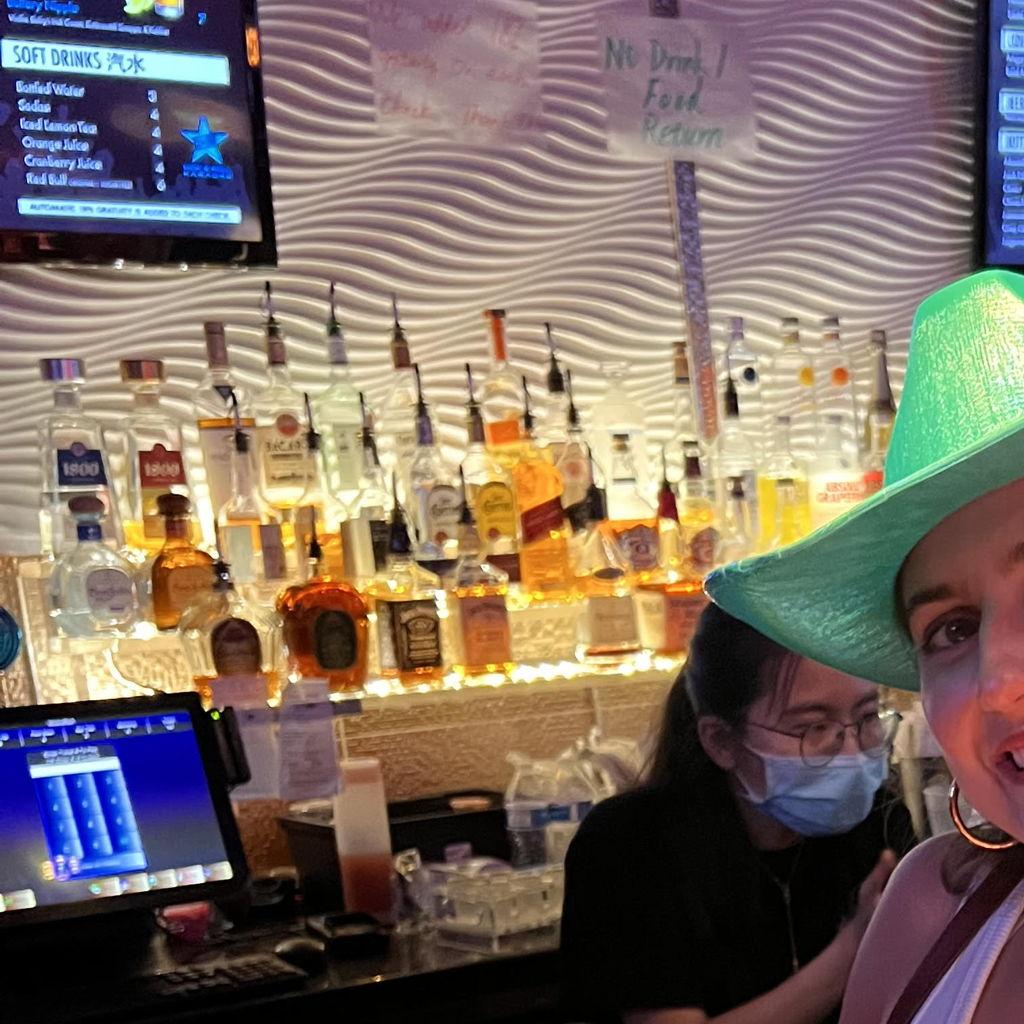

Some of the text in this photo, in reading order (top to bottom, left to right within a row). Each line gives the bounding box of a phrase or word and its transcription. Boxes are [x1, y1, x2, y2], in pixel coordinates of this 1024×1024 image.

[13, 45, 45, 66] SOFT
[51, 49, 101, 70] DRINKS
[16, 80, 85, 97] Bottled Water
[642, 75, 703, 111] Food
[20, 117, 98, 134] Iced Lemon Tea
[642, 113, 724, 148] Return
[21, 136, 90, 153] Orange Juice
[24, 154, 103, 171] Cranberry Juice
[26, 172, 47, 185] Red
[48, 173, 68, 187] Bull
[63, 462, 100, 477] 1800
